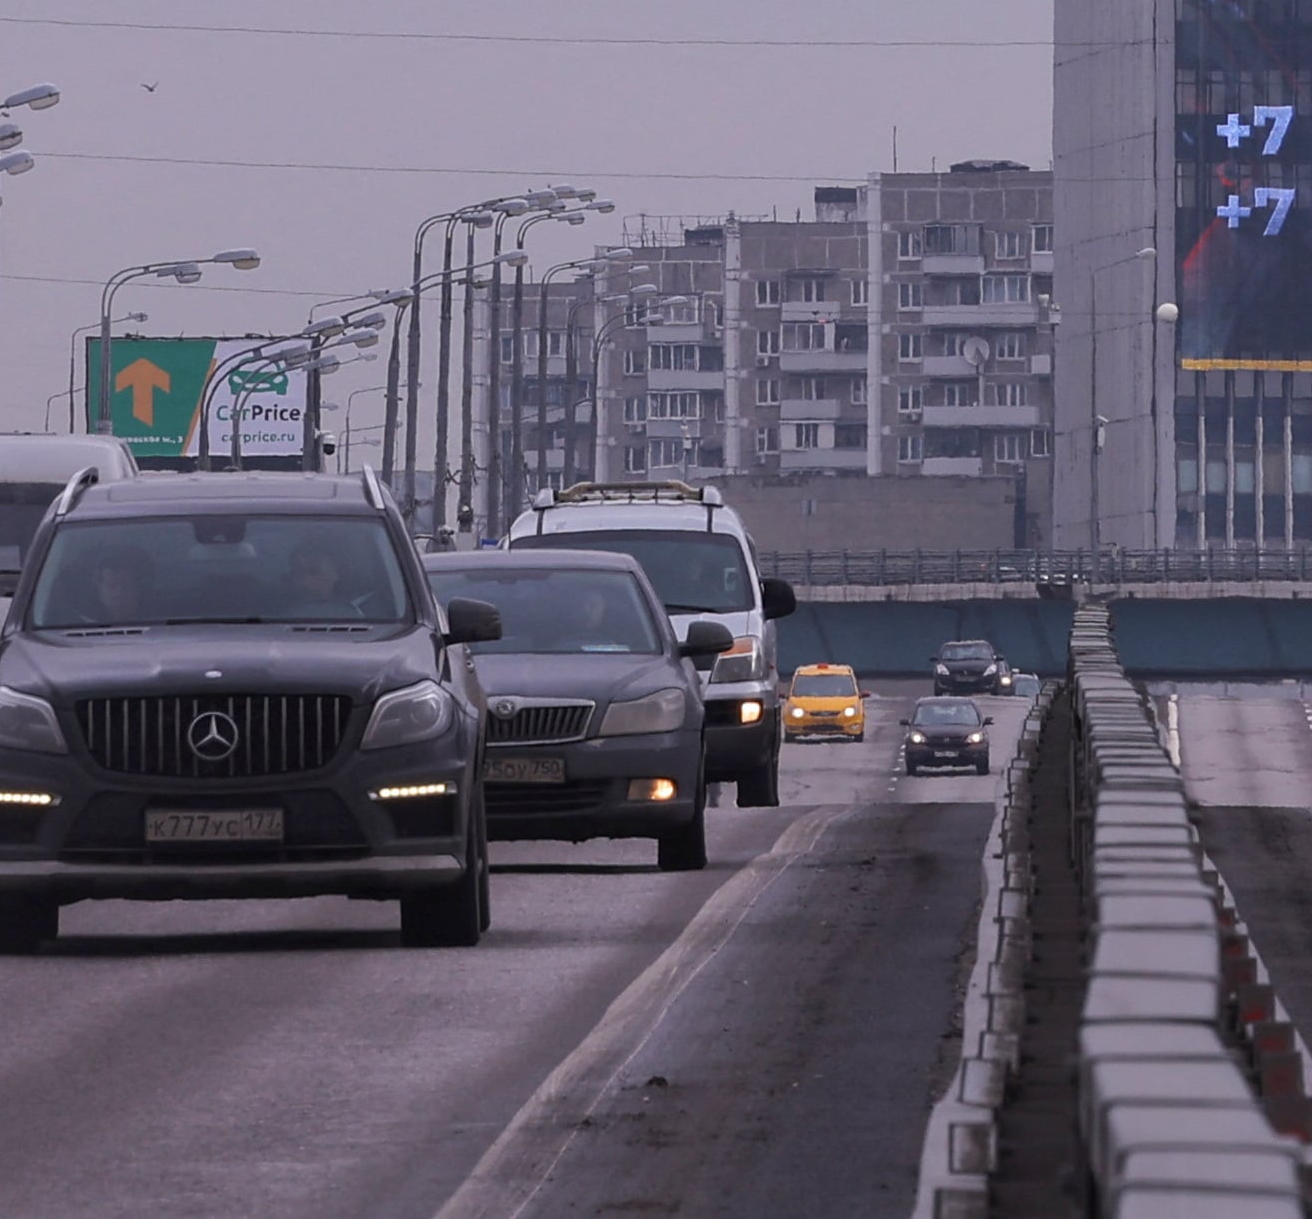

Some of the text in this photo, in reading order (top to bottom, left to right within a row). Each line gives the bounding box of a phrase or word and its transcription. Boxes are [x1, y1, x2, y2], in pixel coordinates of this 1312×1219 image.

[1216, 105, 1294, 156] +7
[1216, 186, 1295, 238] +7
[221, 431, 295, 443] cprice.ru
